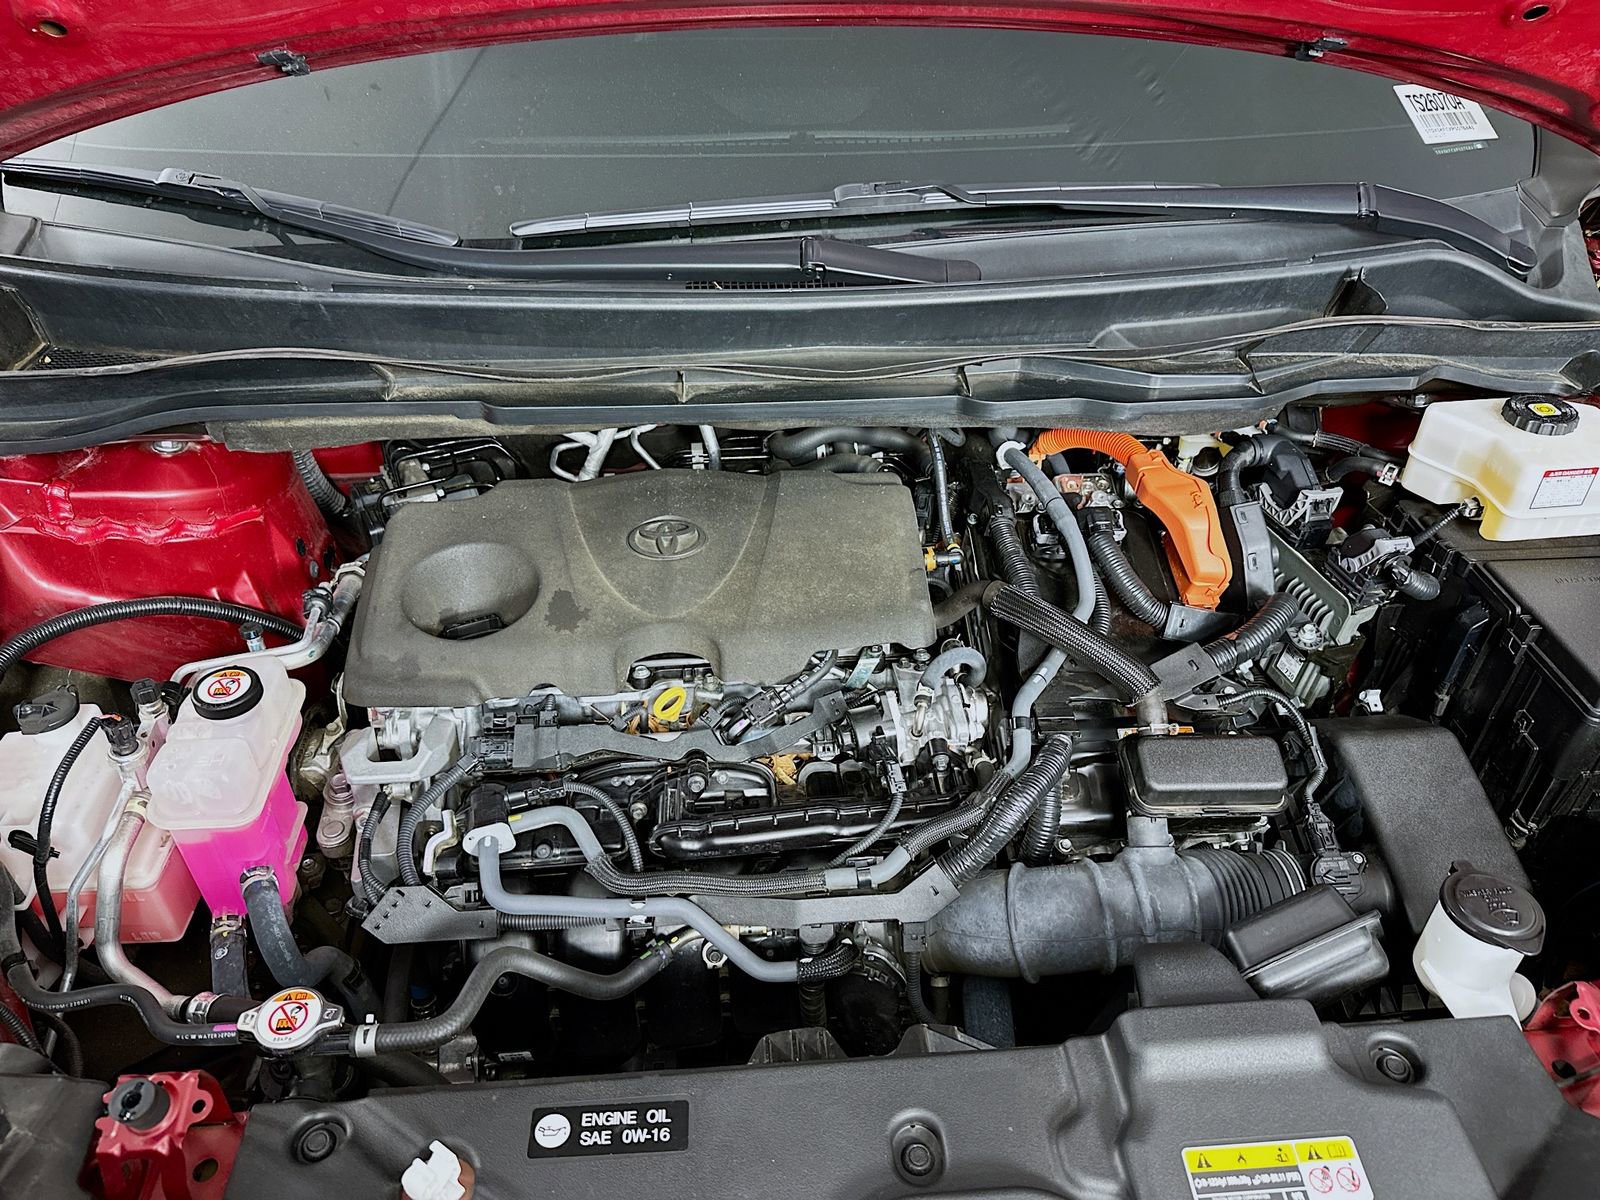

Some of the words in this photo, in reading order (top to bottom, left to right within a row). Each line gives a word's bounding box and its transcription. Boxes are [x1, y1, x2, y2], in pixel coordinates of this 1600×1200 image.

[581, 1111, 637, 1127] ENGINE
[646, 1108, 672, 1124] OIL
[579, 1131, 612, 1146] SAE
[621, 1128, 671, 1144] 0W-16
